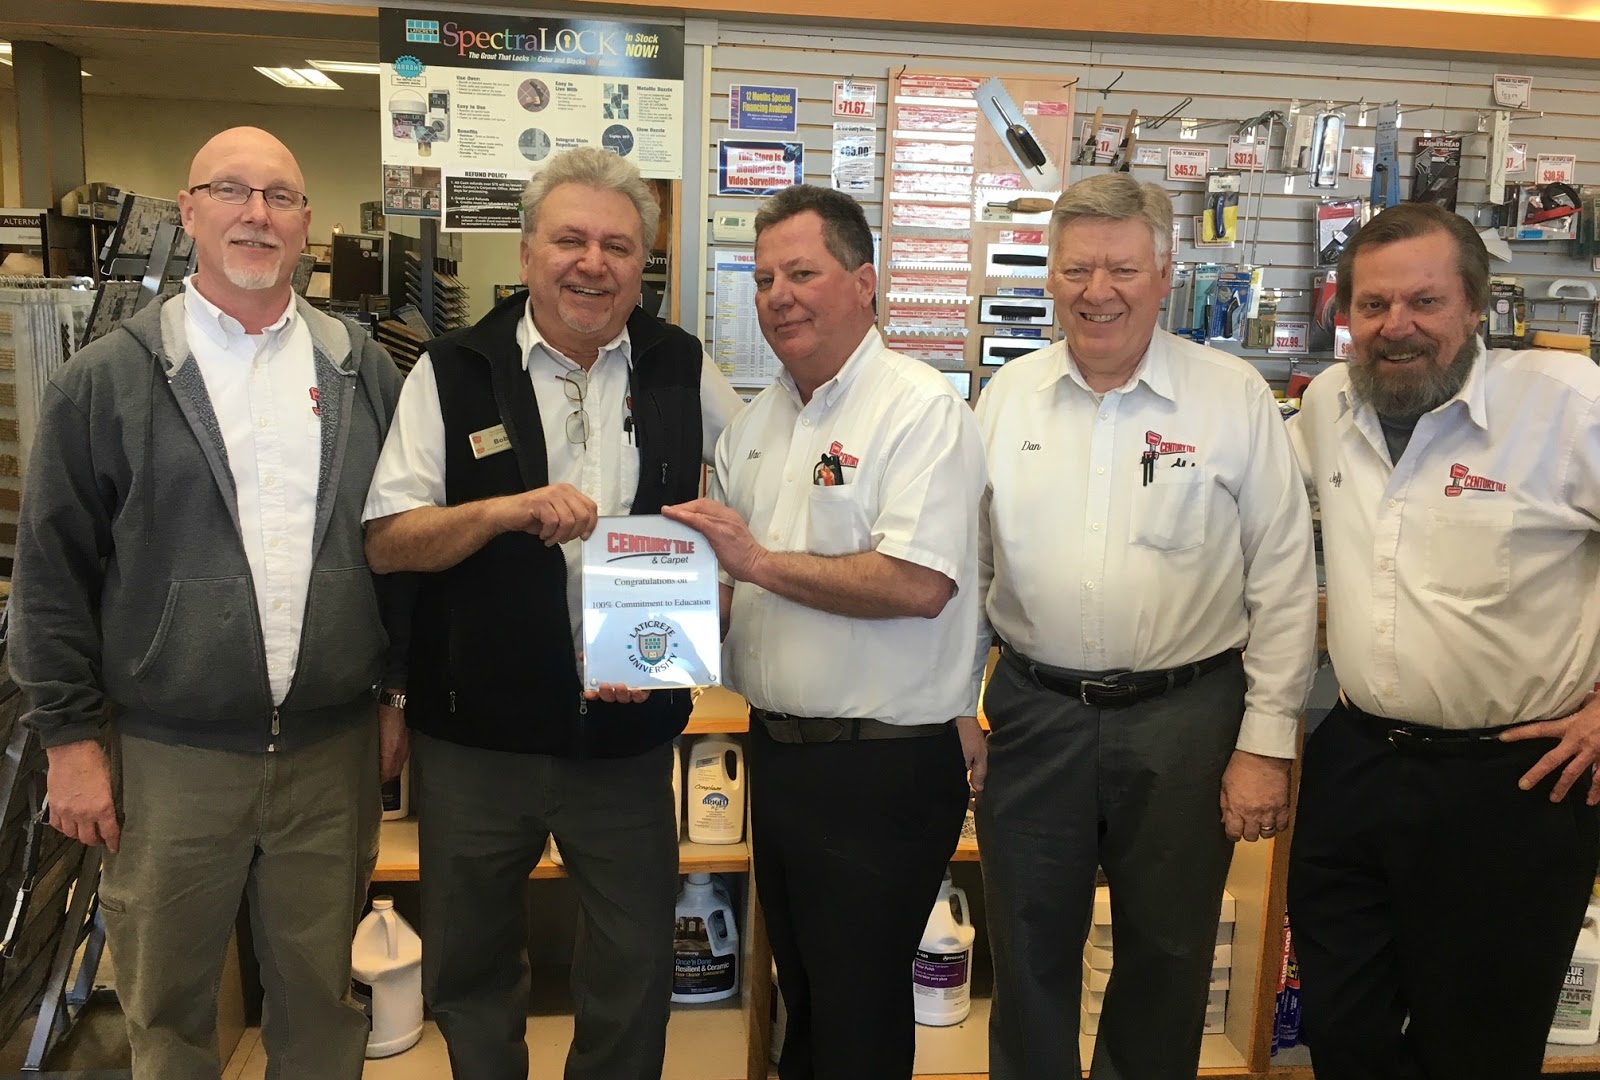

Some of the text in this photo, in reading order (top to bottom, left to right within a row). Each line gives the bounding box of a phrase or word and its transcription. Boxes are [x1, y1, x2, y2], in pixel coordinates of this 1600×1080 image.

[625, 33, 659, 44] In Stock
[625, 44, 659, 58] NOW!
[498, 53, 511, 61] That
[512, 54, 530, 62] Locks
[772, 93, 790, 102] Special
[743, 102, 793, 114] Financing Available
[838, 101, 865, 114] $71.67
[754, 152, 773, 161] Store
[736, 164, 786, 174] Monitored By
[1175, 164, 1197, 176] $45.27
[729, 176, 792, 186] Video Surveillance
[1277, 337, 1299, 348] $22.99
[1021, 441, 1041, 451] Dan
[1160, 442, 1186, 453] CENTURY
[747, 449, 761, 460] Mac
[1464, 474, 1506, 492] CENTURY TILE
[607, 532, 695, 554] CENTURY TILE
[660, 556, 688, 565] Carpet
[614, 578, 675, 587] Congratulations
[615, 600, 663, 608] Commitment
[630, 620, 676, 639] LATICRETE
[628, 653, 678, 674] UNIVERSITY
[676, 964, 700, 972] Resilient
[708, 962, 729, 971] Ceramic
[1566, 966, 1584, 976] LUE
[1564, 975, 1584, 985] EAR
